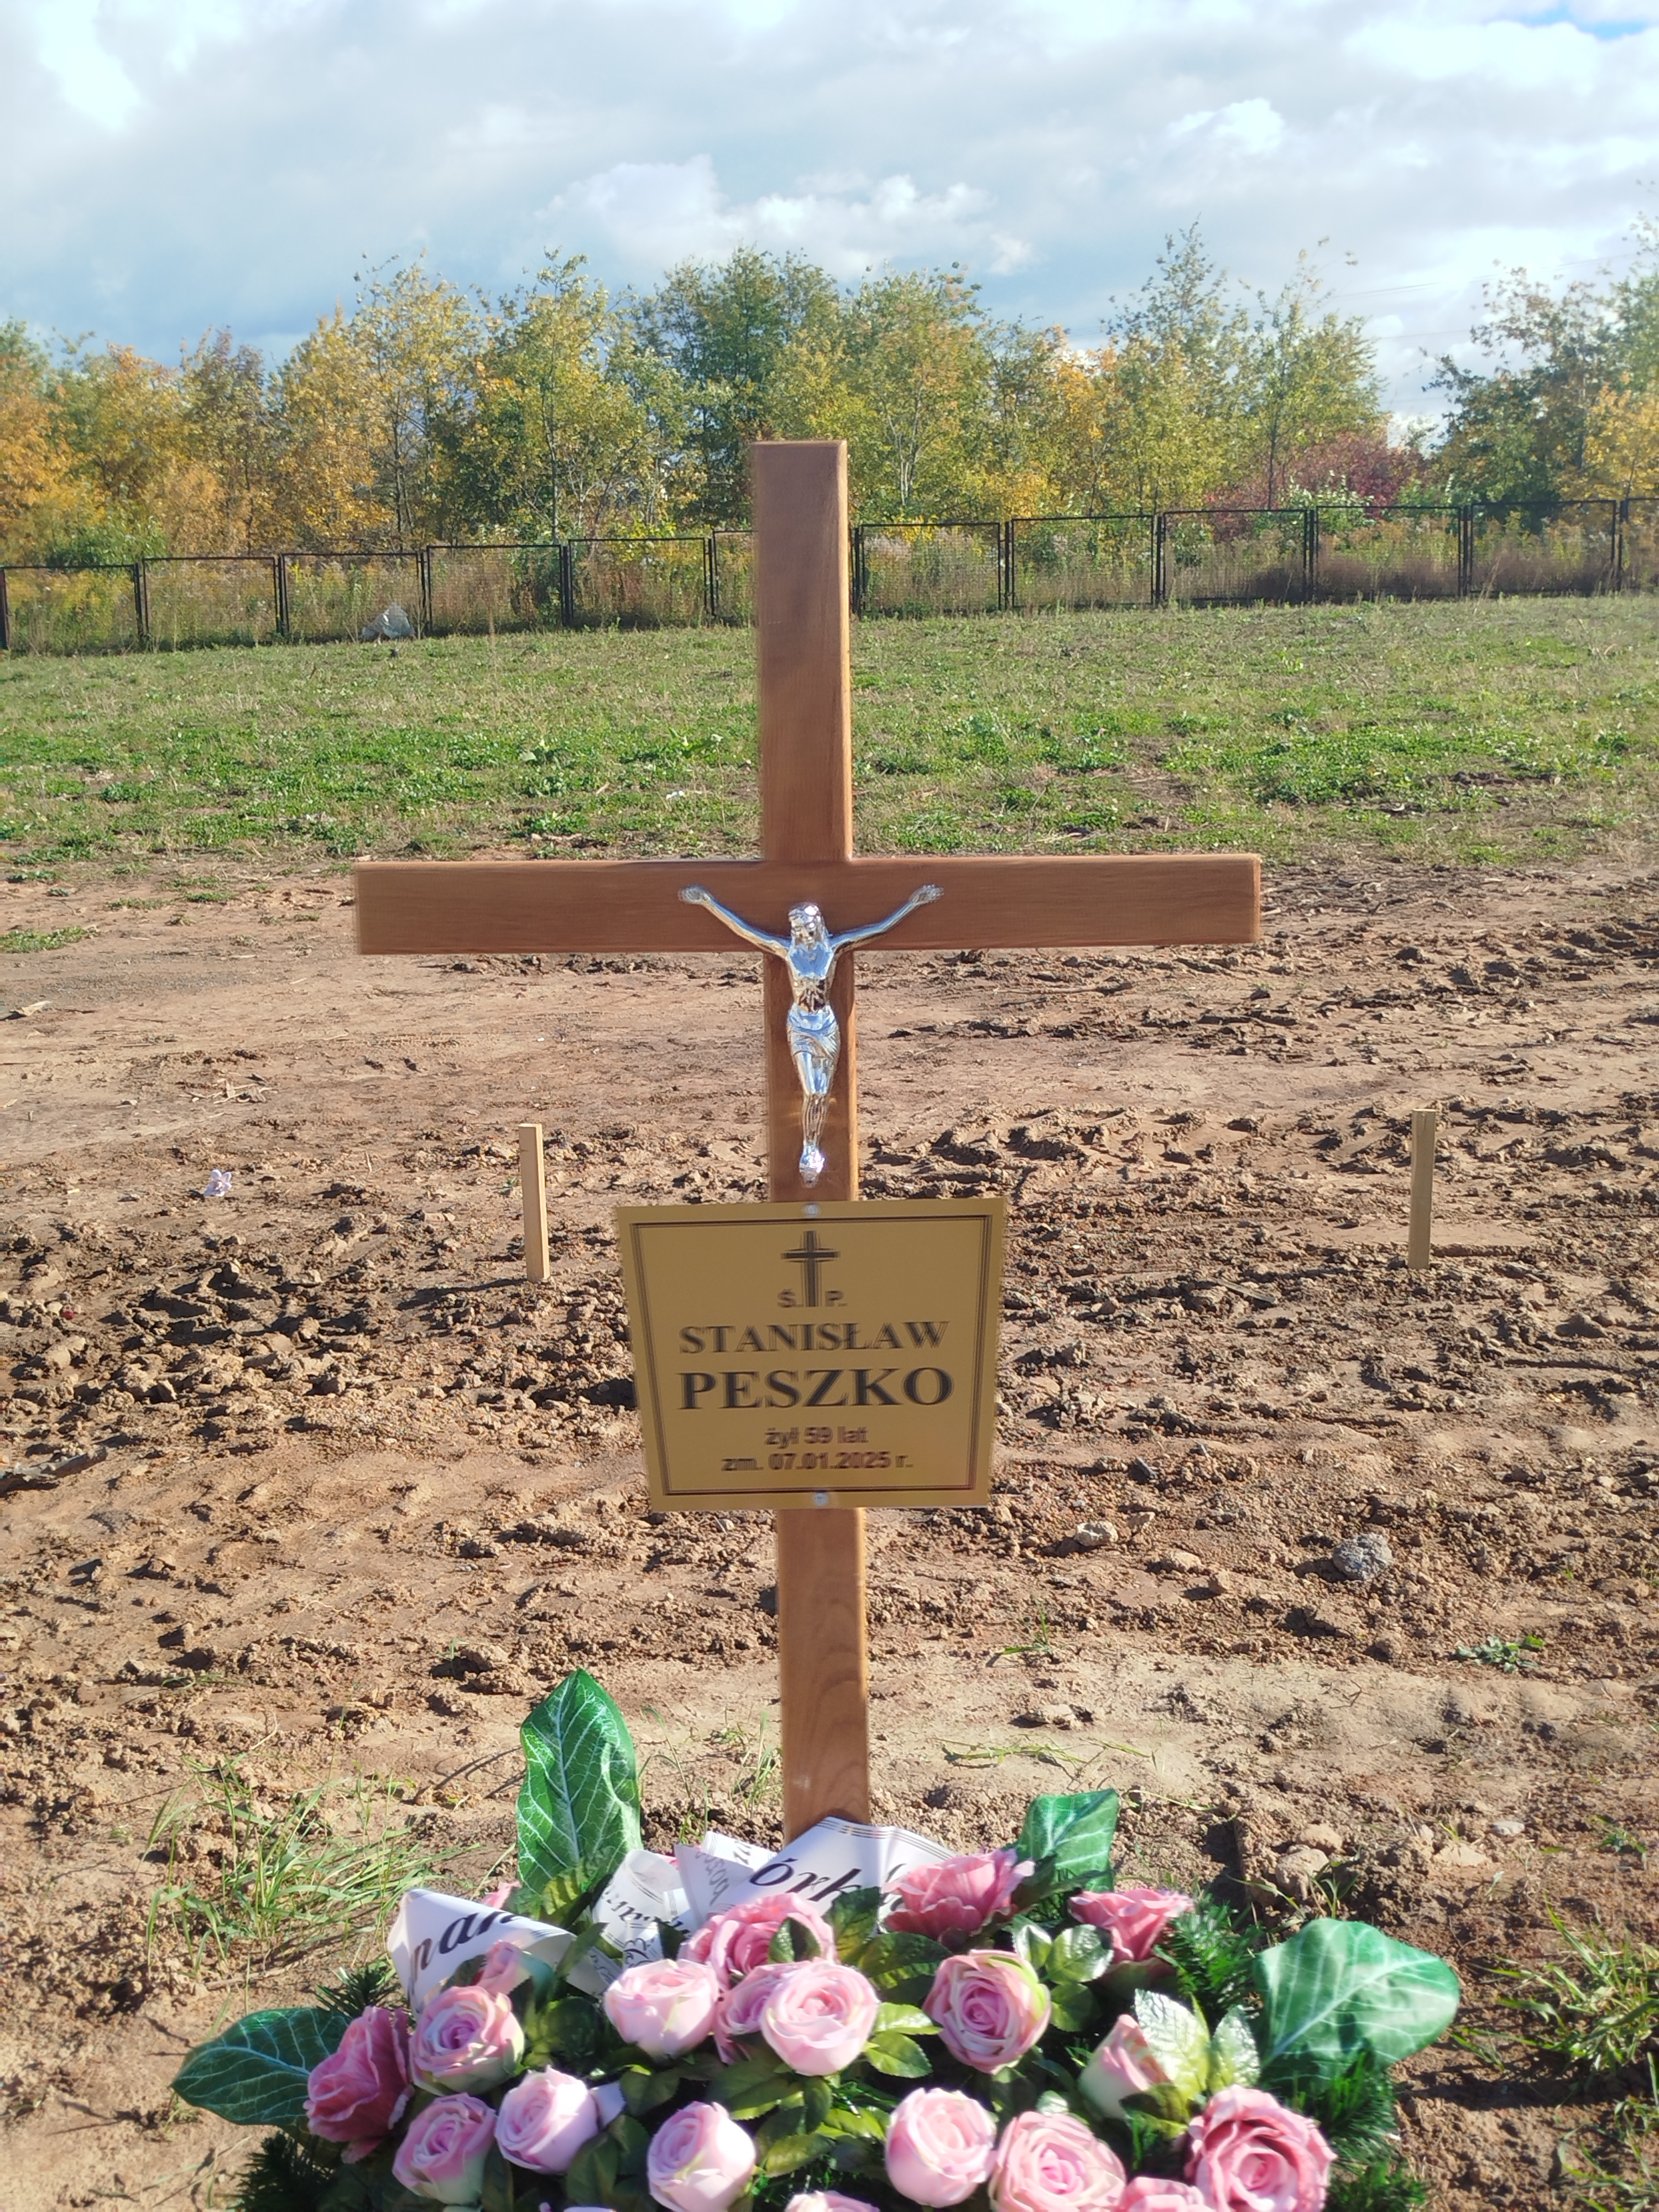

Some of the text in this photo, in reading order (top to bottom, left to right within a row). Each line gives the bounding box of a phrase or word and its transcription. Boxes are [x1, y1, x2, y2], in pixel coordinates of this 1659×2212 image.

[679, 1321, 951, 1354] STANISŁAW
[677, 1367, 954, 1410] PESZKO
[764, 1425, 869, 1449] żył 59 lat
[721, 1451, 914, 1471] zm. 07.01.2025 r.
